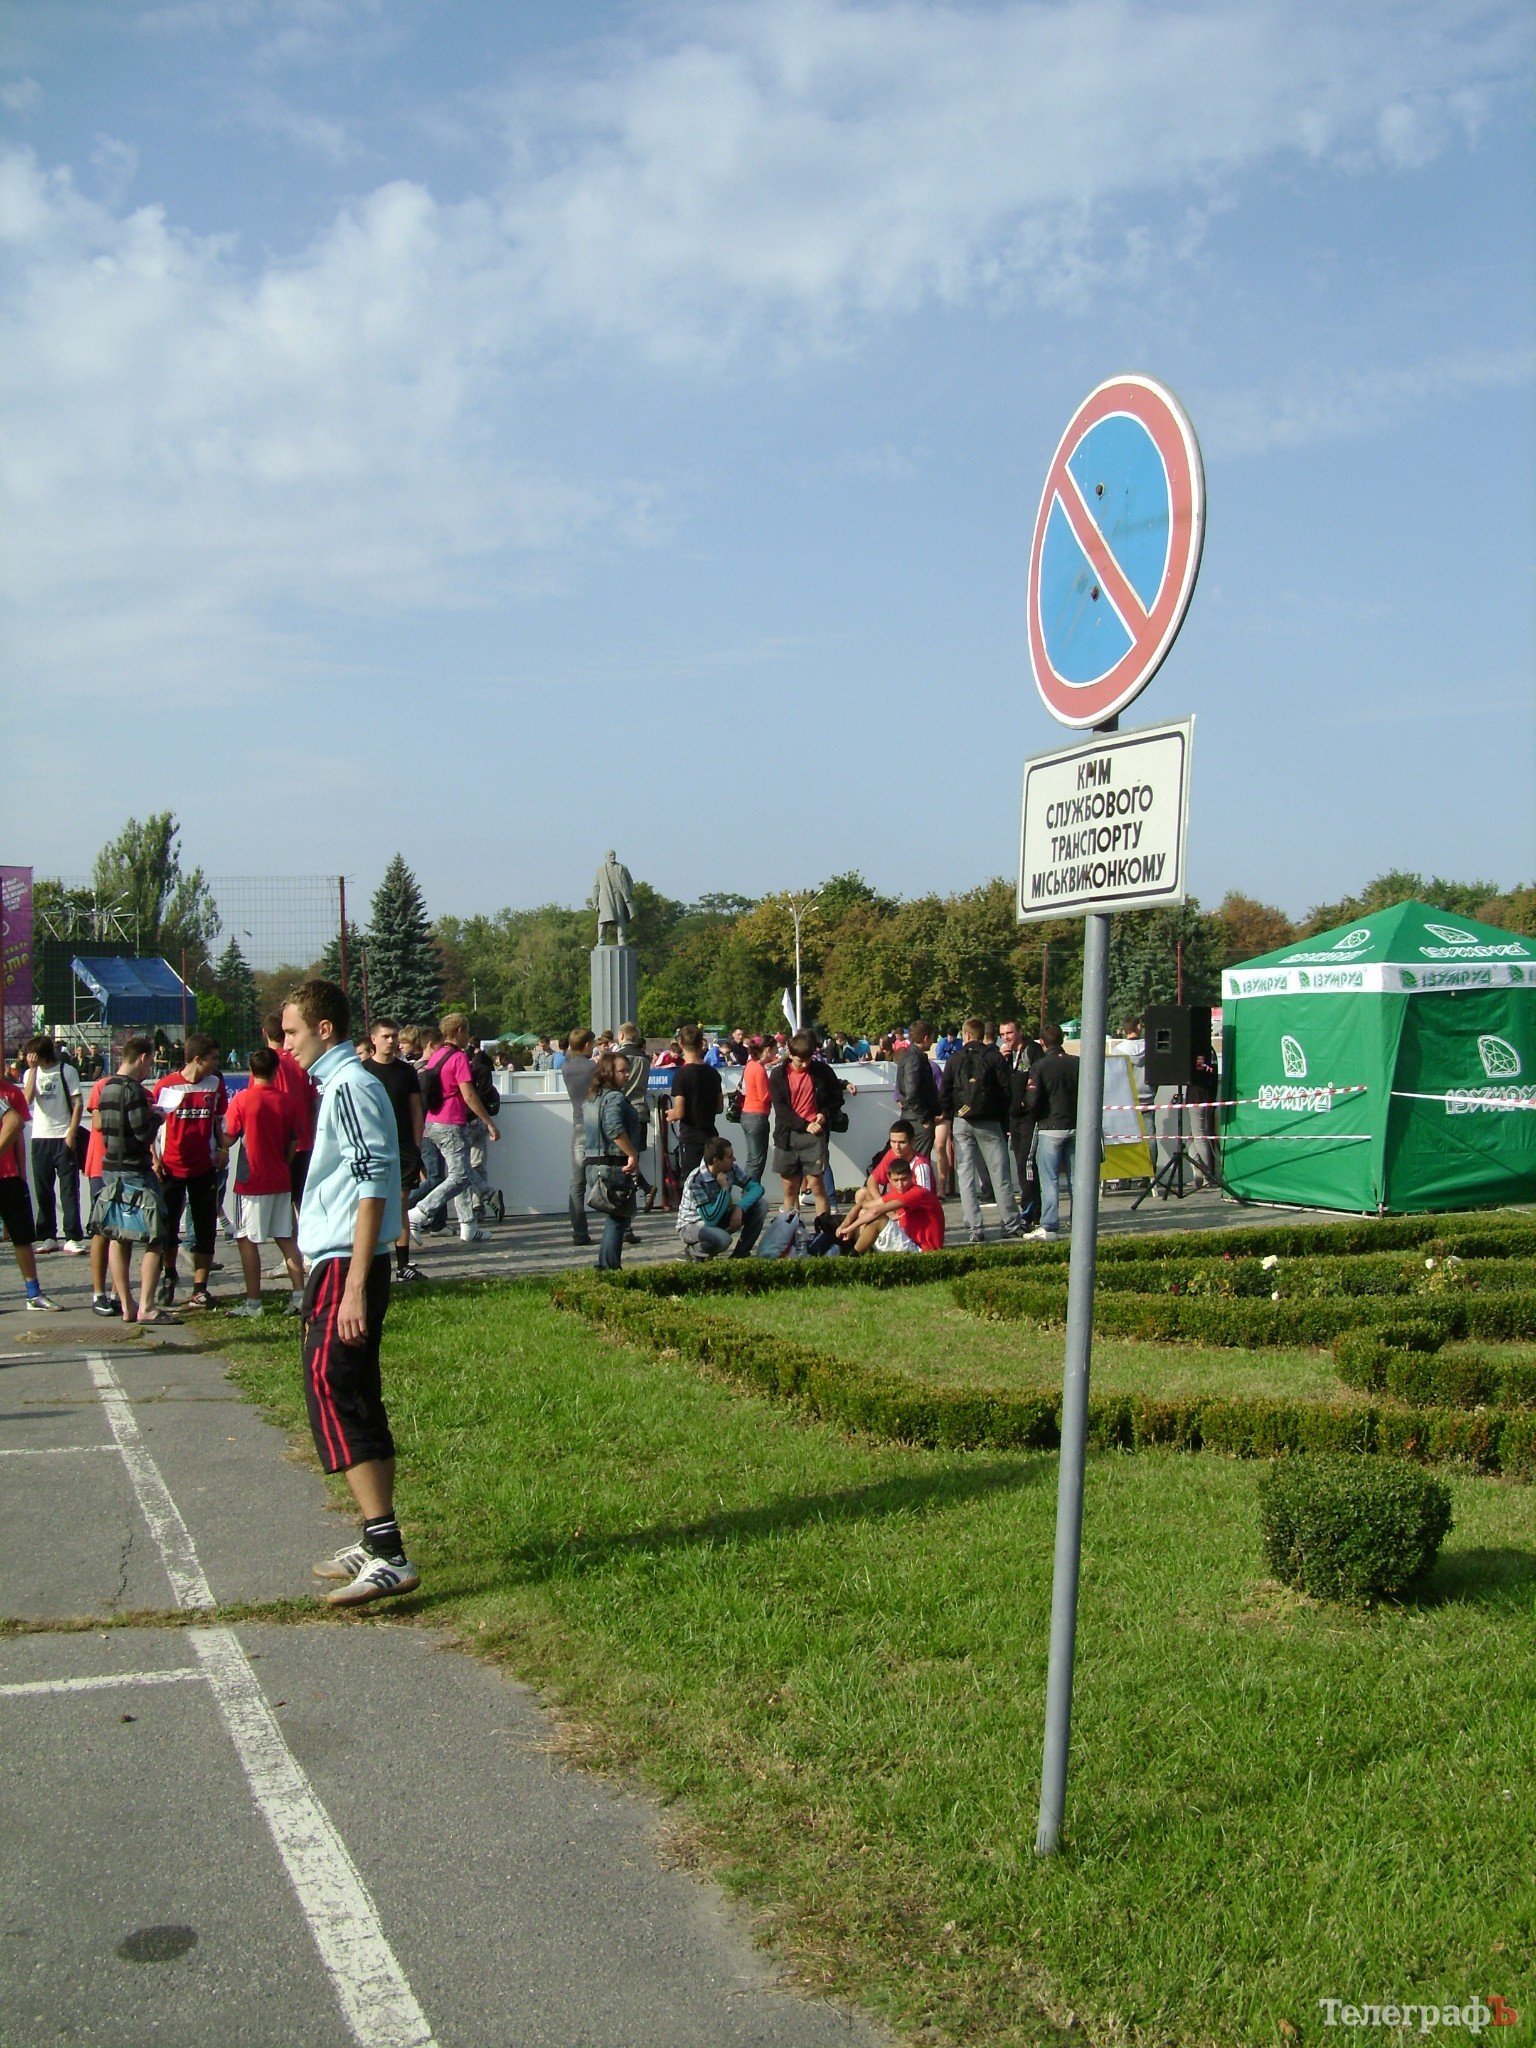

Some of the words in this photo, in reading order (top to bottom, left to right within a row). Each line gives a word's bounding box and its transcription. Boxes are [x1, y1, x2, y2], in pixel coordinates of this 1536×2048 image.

[1077, 757, 1112, 790] КРІМ
[1046, 784, 1153, 829] СЛУЖБОВОГО
[1051, 820, 1143, 863] ТРАНСПОРТУ
[1031, 852, 1166, 899] МІСЬКВИКОНКОМУ
